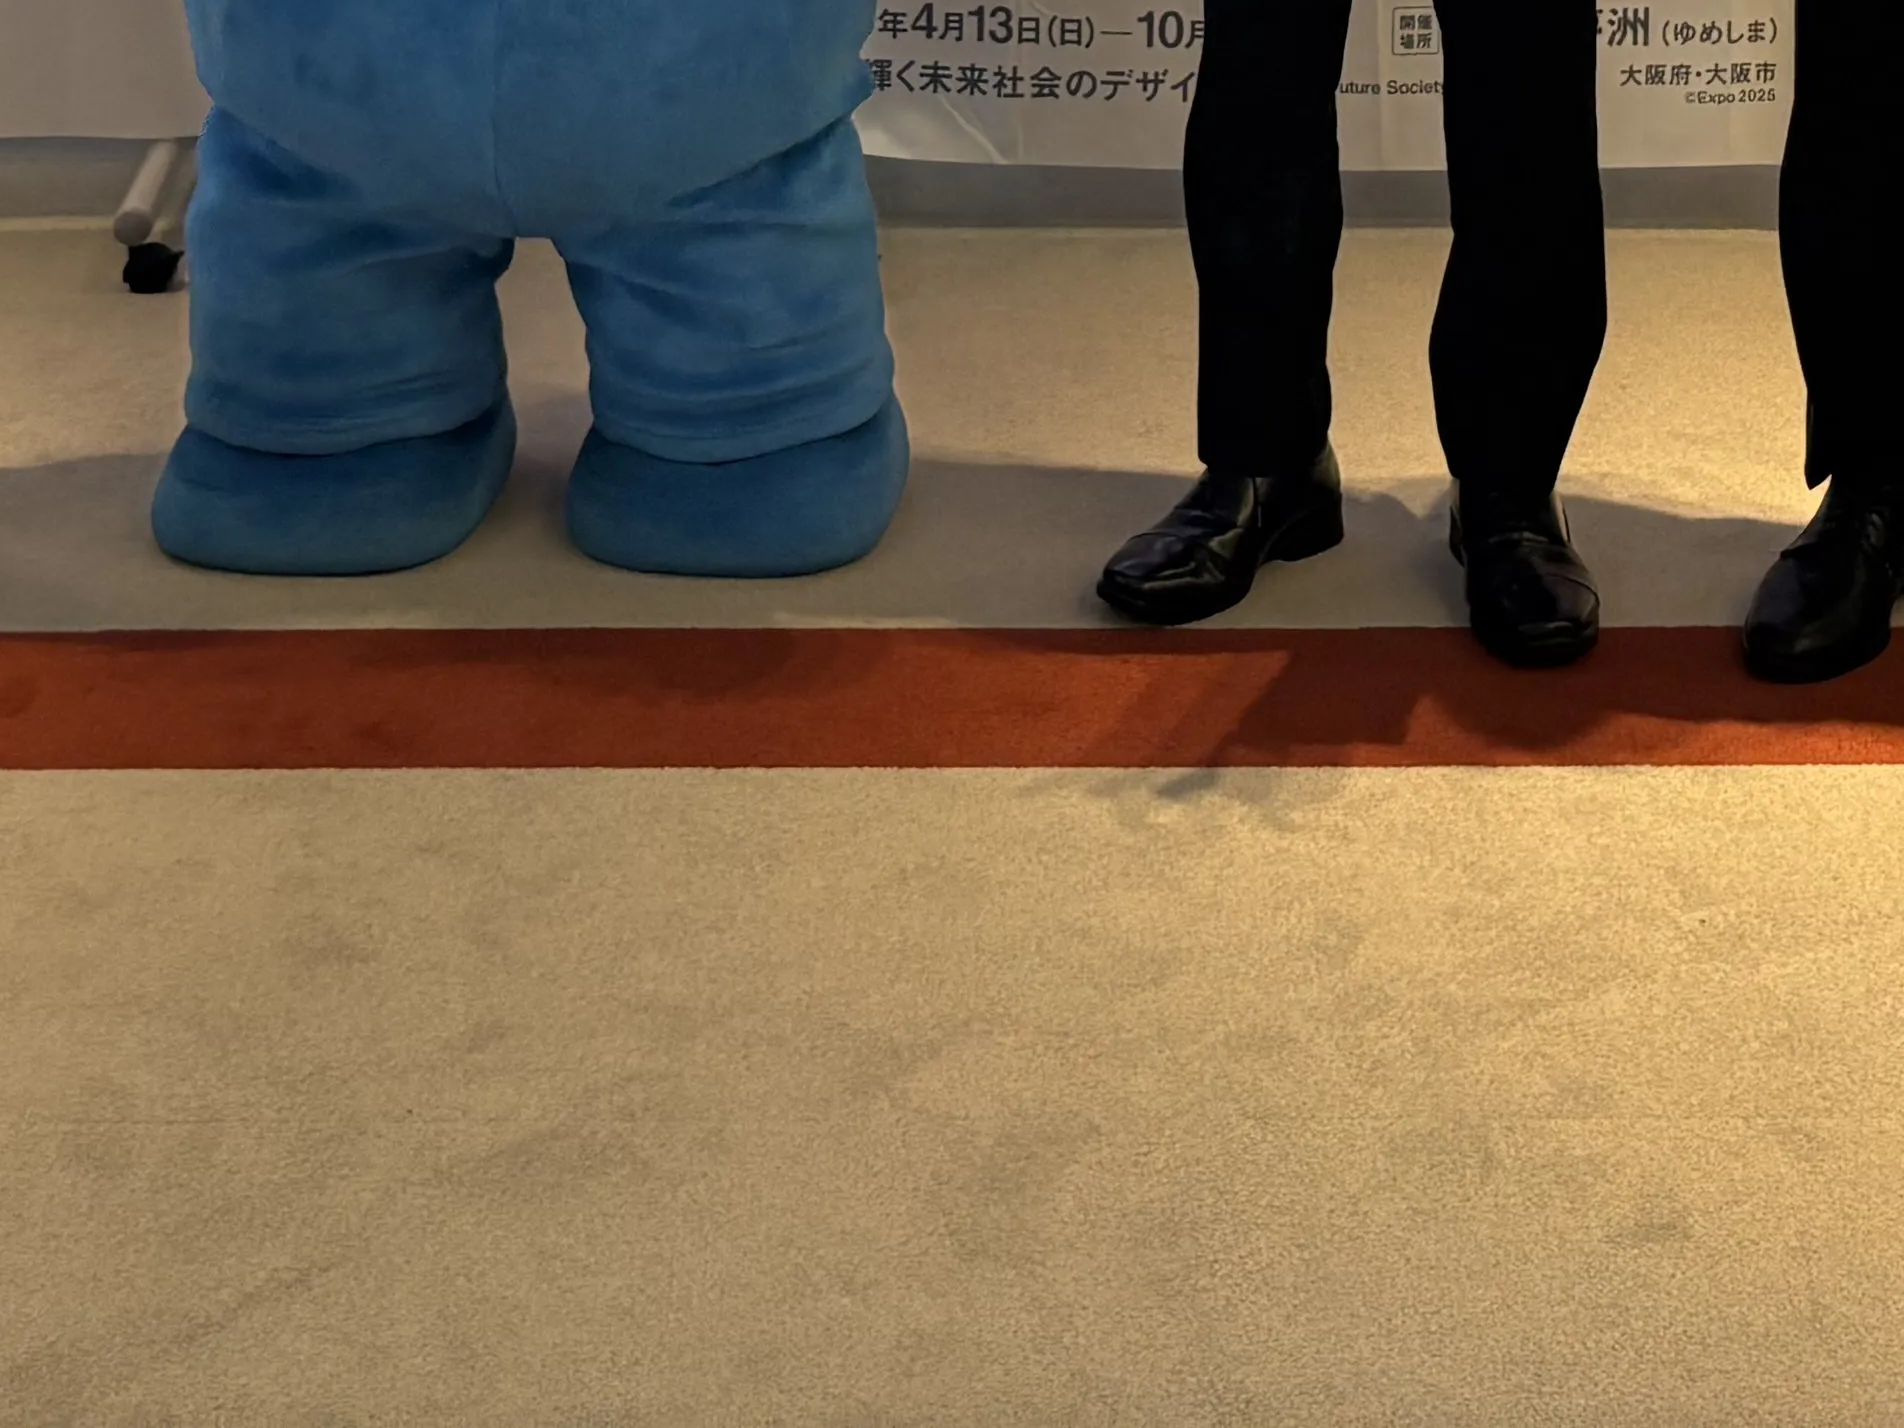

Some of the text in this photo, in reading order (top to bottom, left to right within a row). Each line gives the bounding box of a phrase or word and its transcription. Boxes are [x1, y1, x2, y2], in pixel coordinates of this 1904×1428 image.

[1399, 14, 1433, 31] 開催
[1662, 17, 1778, 47] (ゆめしま)
[1399, 32, 1433, 50] 場所
[1619, 61, 1778, 87] 大阪府・大阪市
[1339, 80, 1382, 95] uture
[1738, 88, 1777, 104] 2025
